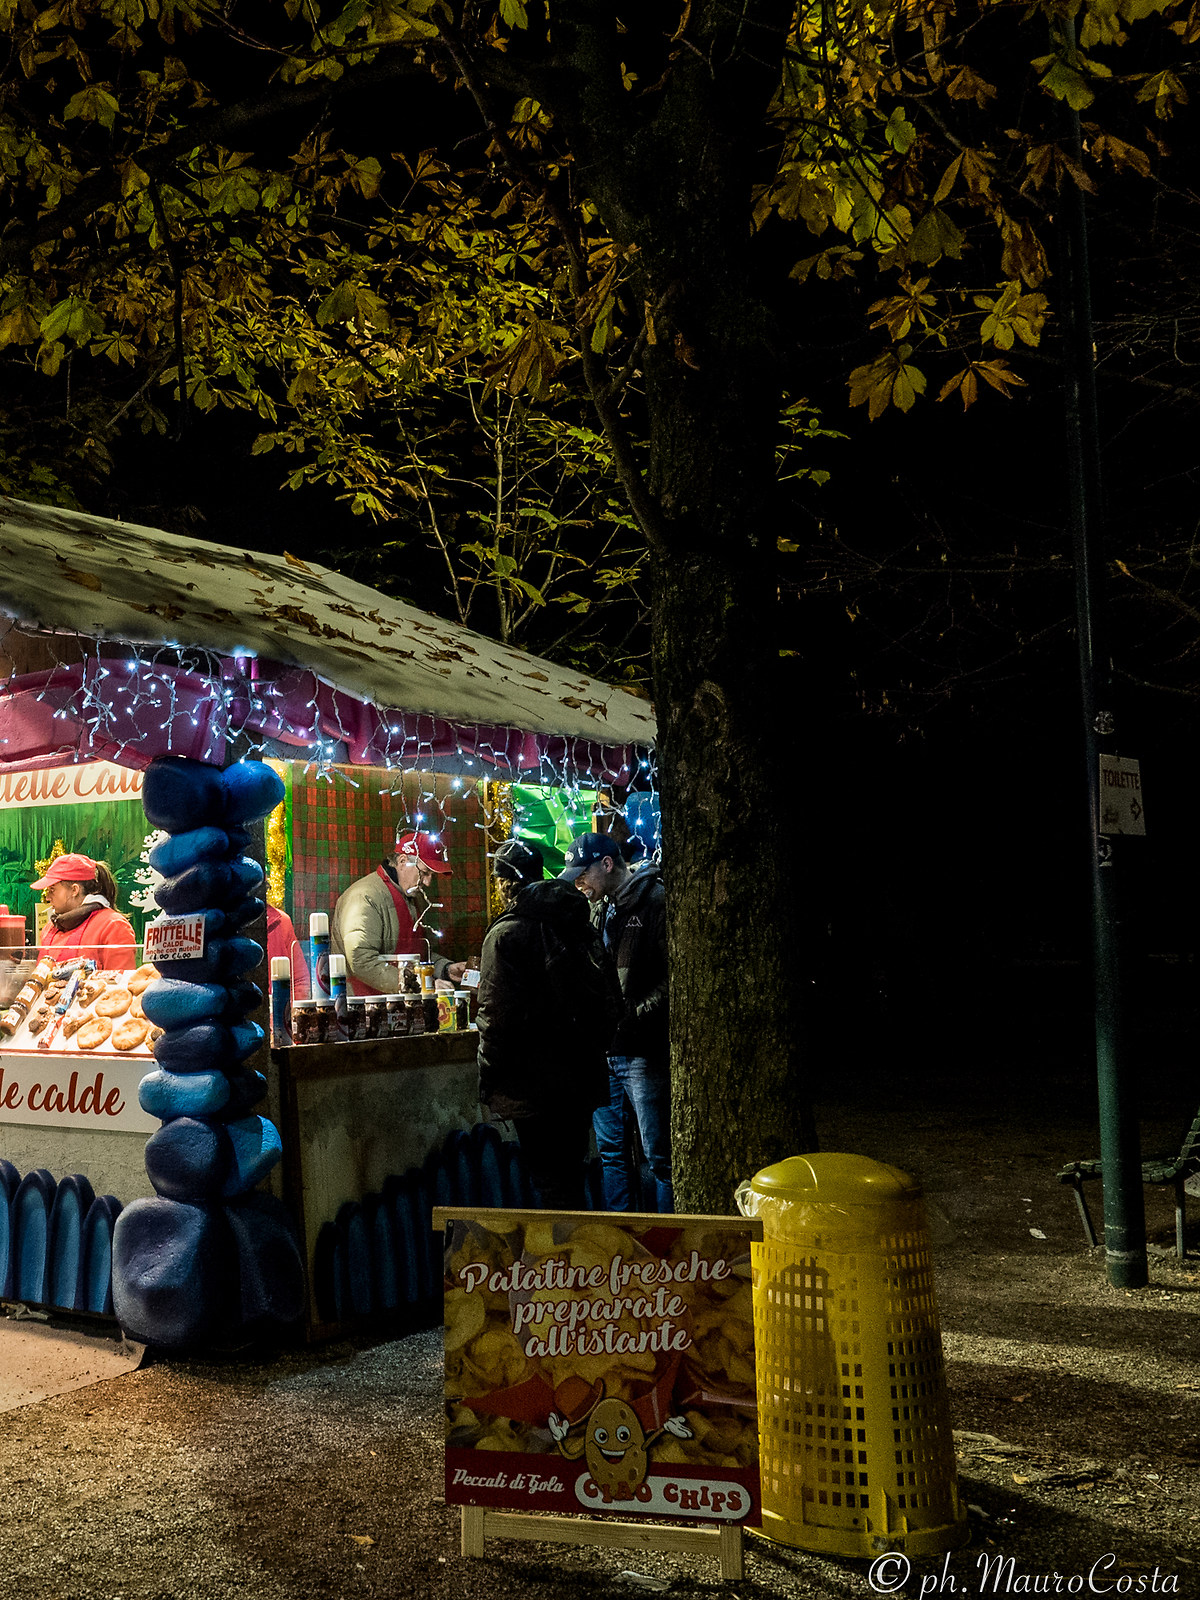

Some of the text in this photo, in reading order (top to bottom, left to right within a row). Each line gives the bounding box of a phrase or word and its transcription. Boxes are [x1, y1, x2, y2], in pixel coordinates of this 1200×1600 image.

[1102, 769, 1139, 789] TOILETTE
[146, 923, 202, 949] FRITTELLE
[27, 1071, 126, 1116] calde
[459, 1251, 732, 1295] Patatine fresche
[512, 1286, 687, 1334] preparate
[525, 1320, 693, 1357] all'istante
[452, 1468, 566, 1495] Peccati di Gola
[663, 1483, 744, 1513] CHIPS
